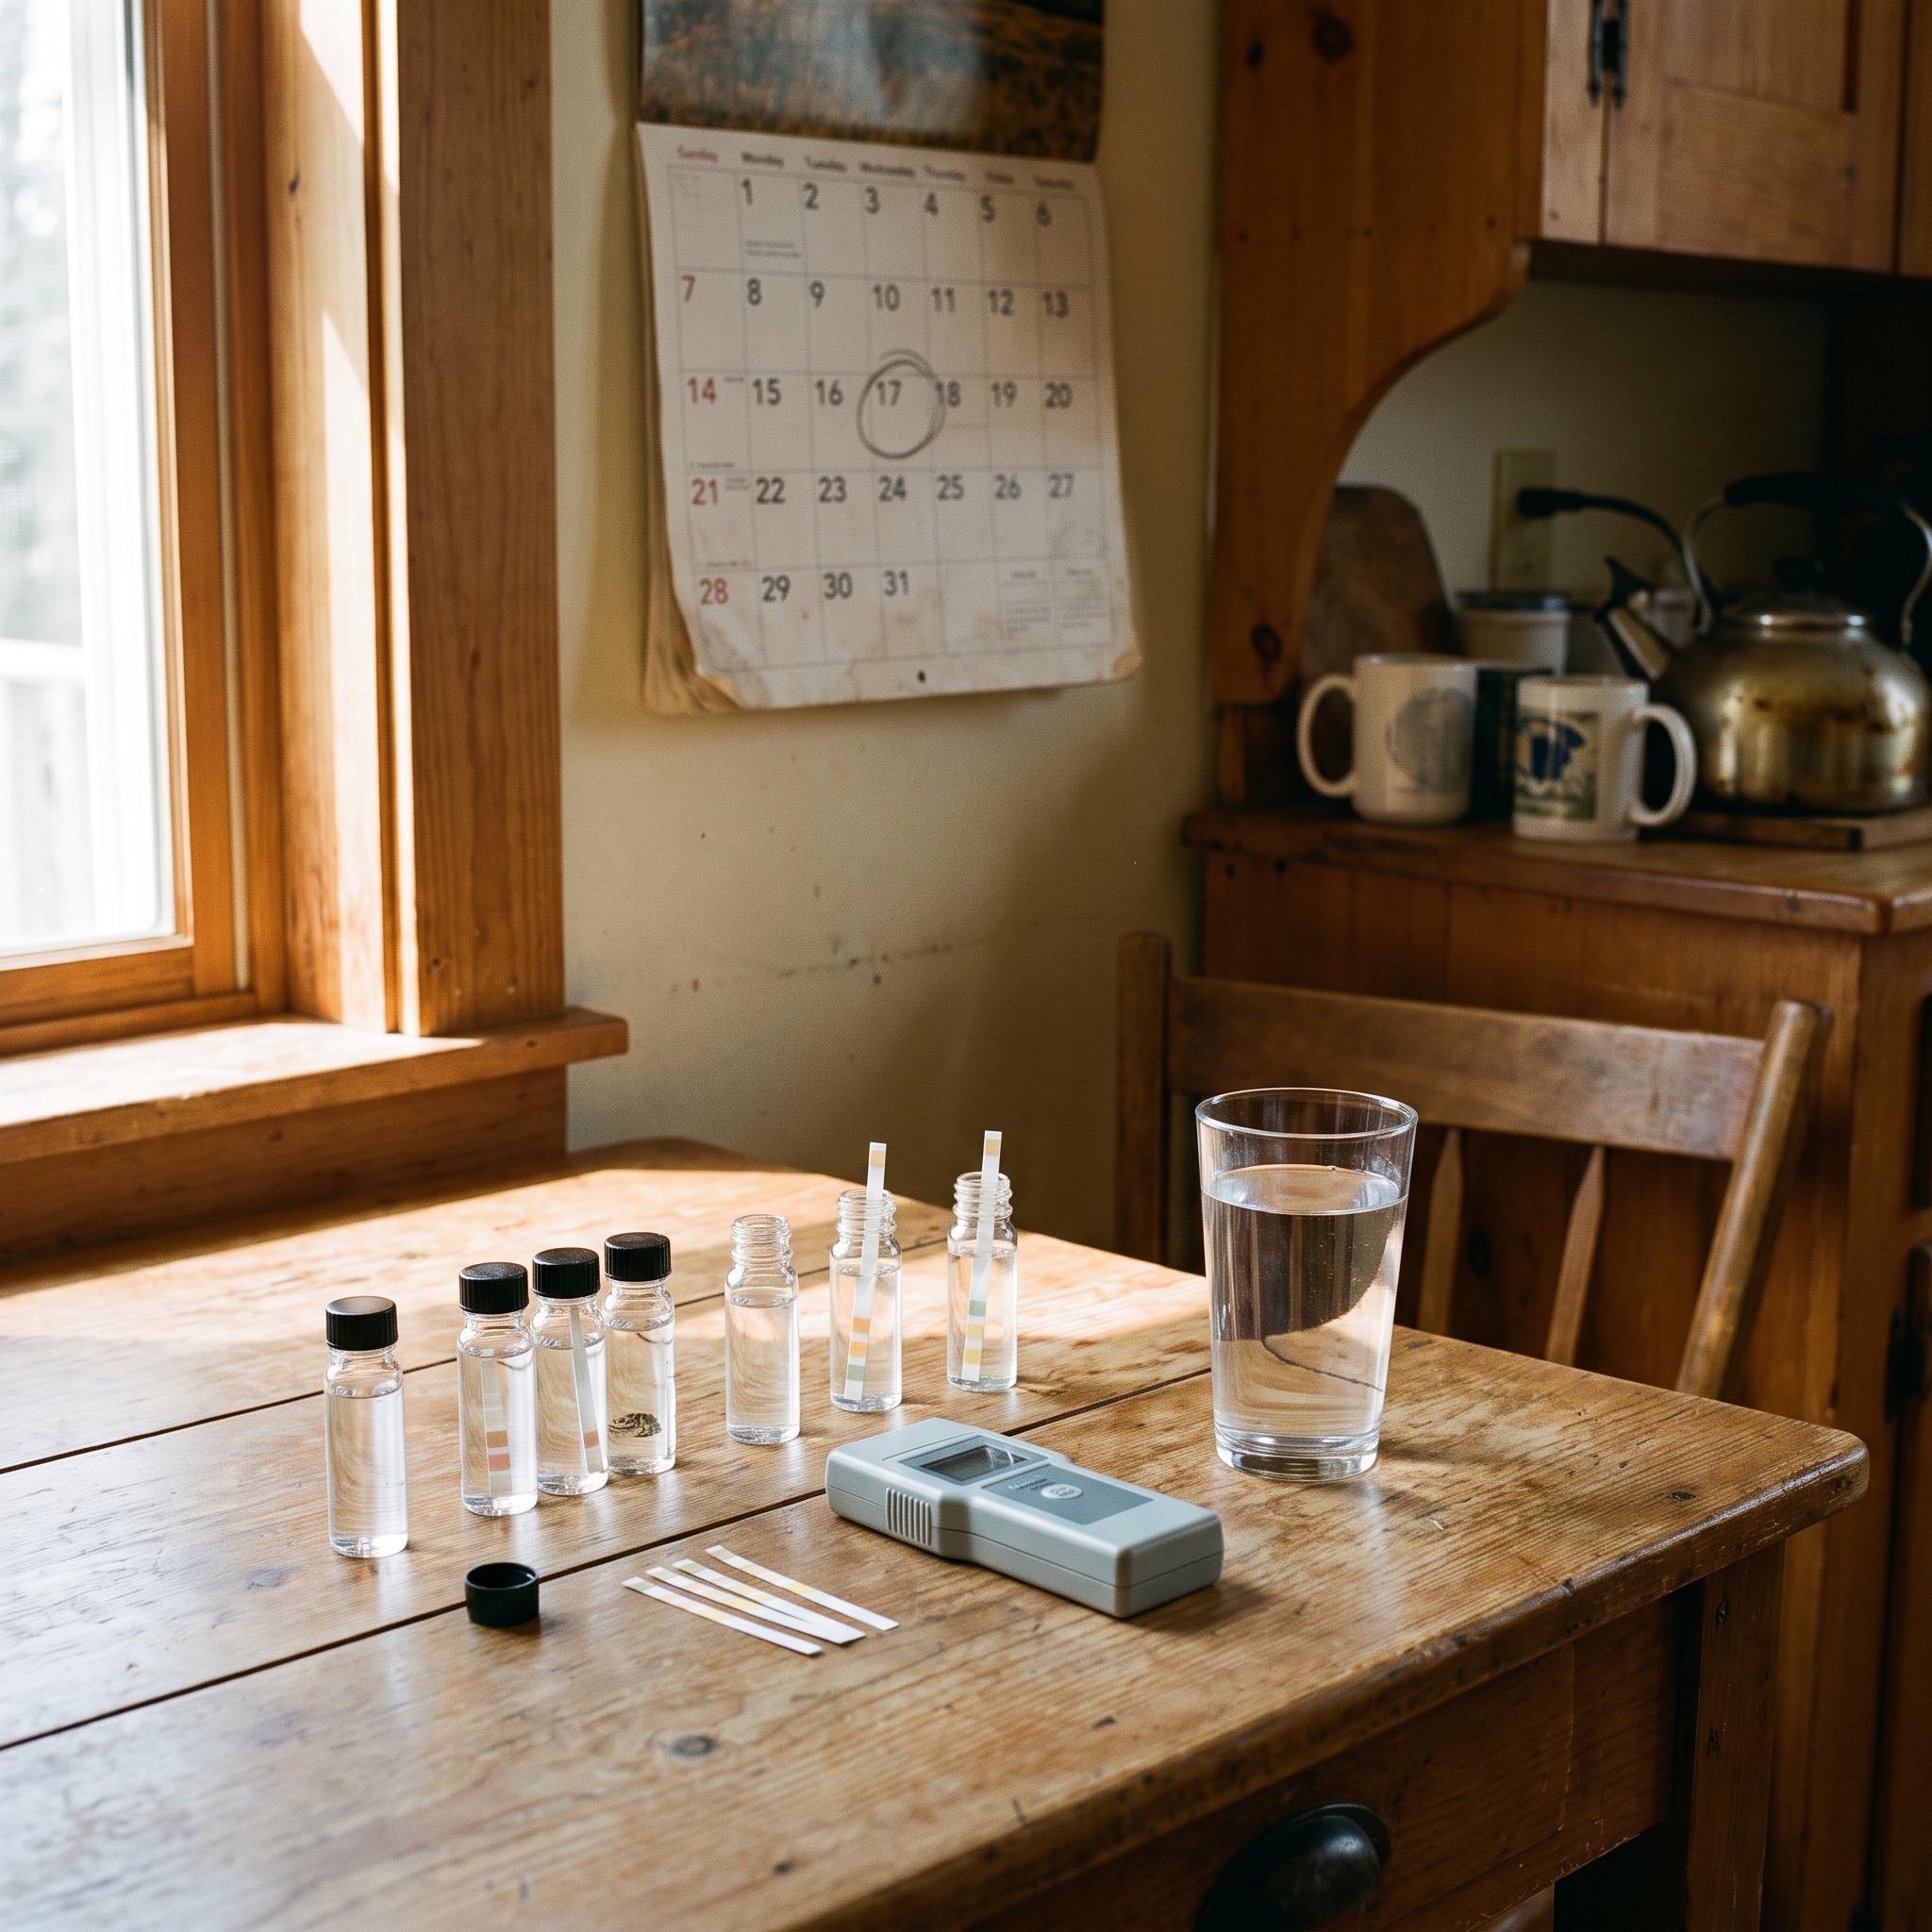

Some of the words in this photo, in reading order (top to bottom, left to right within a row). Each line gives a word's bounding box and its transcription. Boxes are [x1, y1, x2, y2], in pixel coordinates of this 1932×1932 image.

[741, 177, 754, 206] 1
[804, 181, 819, 210] 2
[865, 186, 880, 215] 3
[924, 192, 940, 216] 4
[980, 194, 996, 223] 5
[1036, 200, 1052, 226] 6
[681, 275, 695, 302] 7
[747, 278, 761, 306] 8
[808, 280, 824, 308] 9
[873, 284, 900, 311] 10
[930, 287, 956, 313] 11
[988, 290, 1013, 315] 12
[1042, 291, 1068, 319] 13
[688, 377, 716, 403] 14
[753, 378, 781, 406] 15
[815, 380, 843, 407] 16
[875, 380, 901, 405] 17
[934, 381, 960, 408] 18
[991, 380, 1017, 407] 19
[1044, 383, 1072, 409] 20
[692, 478, 718, 506] 21
[757, 476, 785, 505] 22
[819, 475, 846, 503] 23
[879, 475, 907, 502] 24
[938, 475, 963, 501] 25
[994, 475, 1021, 500] 26
[1049, 473, 1075, 499] 27
[700, 577, 728, 605] 28
[762, 575, 791, 602] 29
[824, 572, 853, 600] 30
[884, 570, 908, 597] 31
